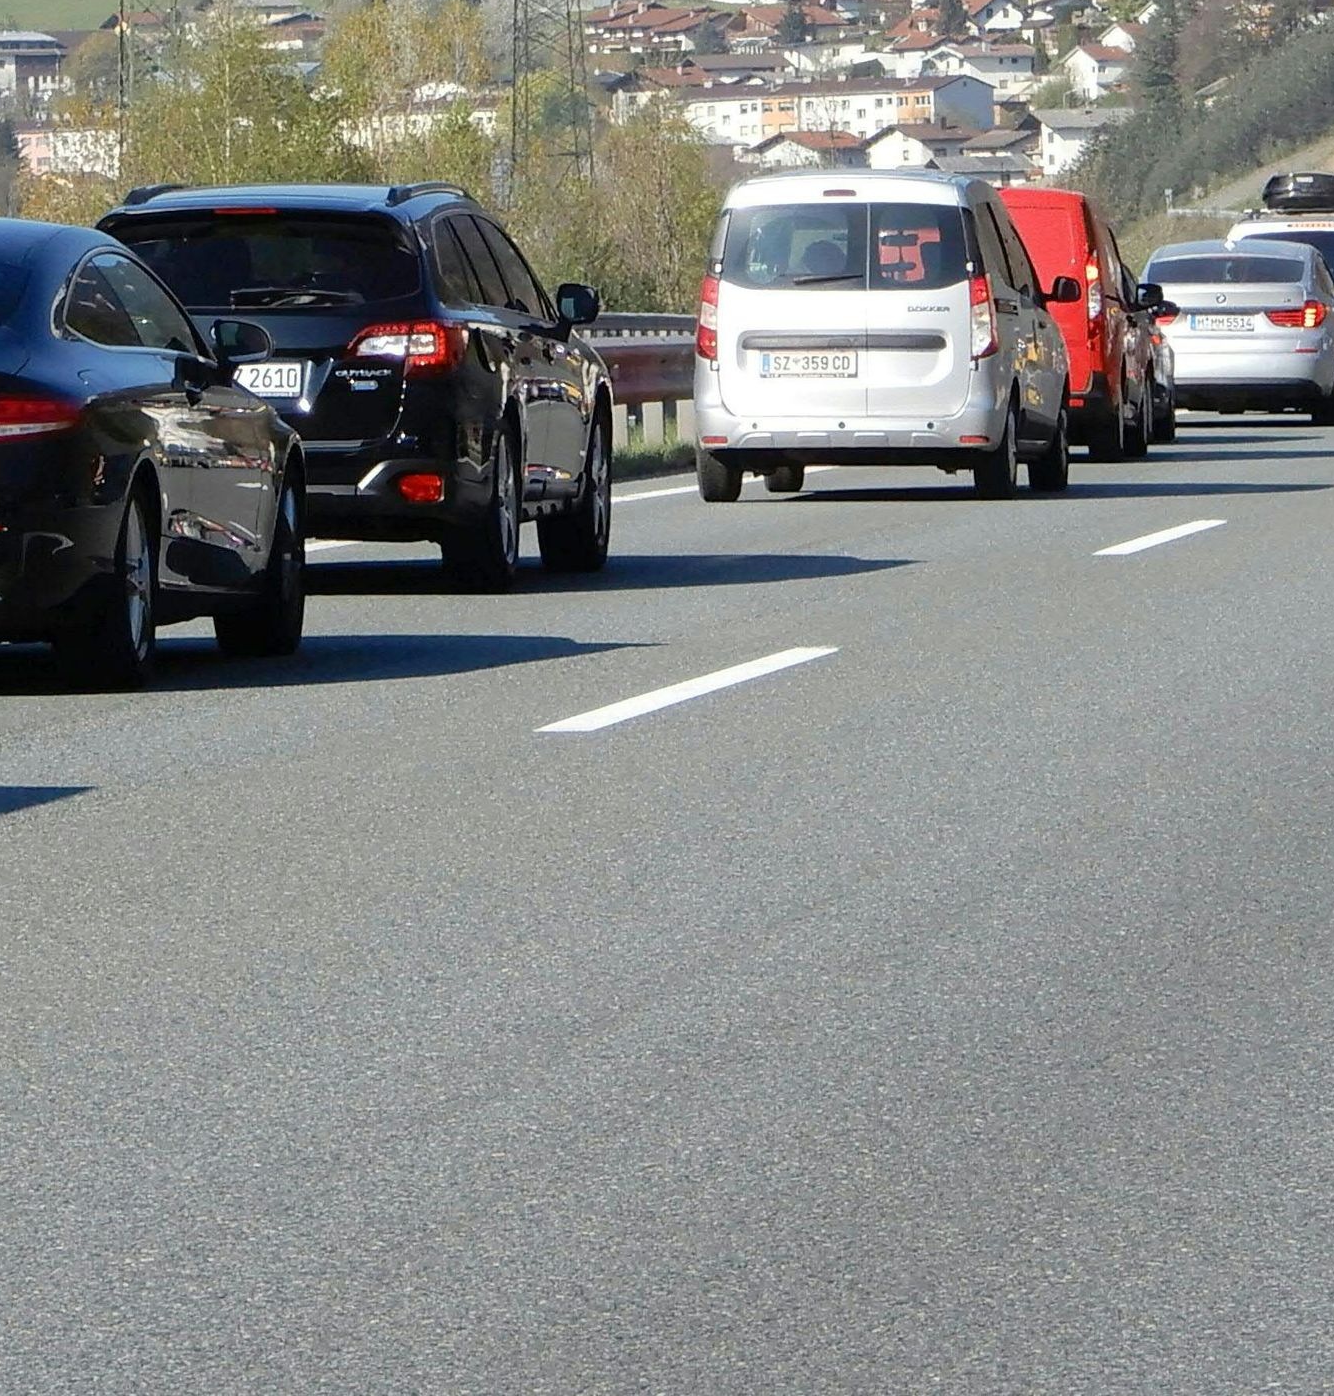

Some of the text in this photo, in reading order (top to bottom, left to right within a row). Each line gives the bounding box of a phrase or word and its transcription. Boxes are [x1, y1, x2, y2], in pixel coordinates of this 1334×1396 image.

[773, 355, 851, 371] SZ 359 CD
[249, 367, 298, 388] 2610
